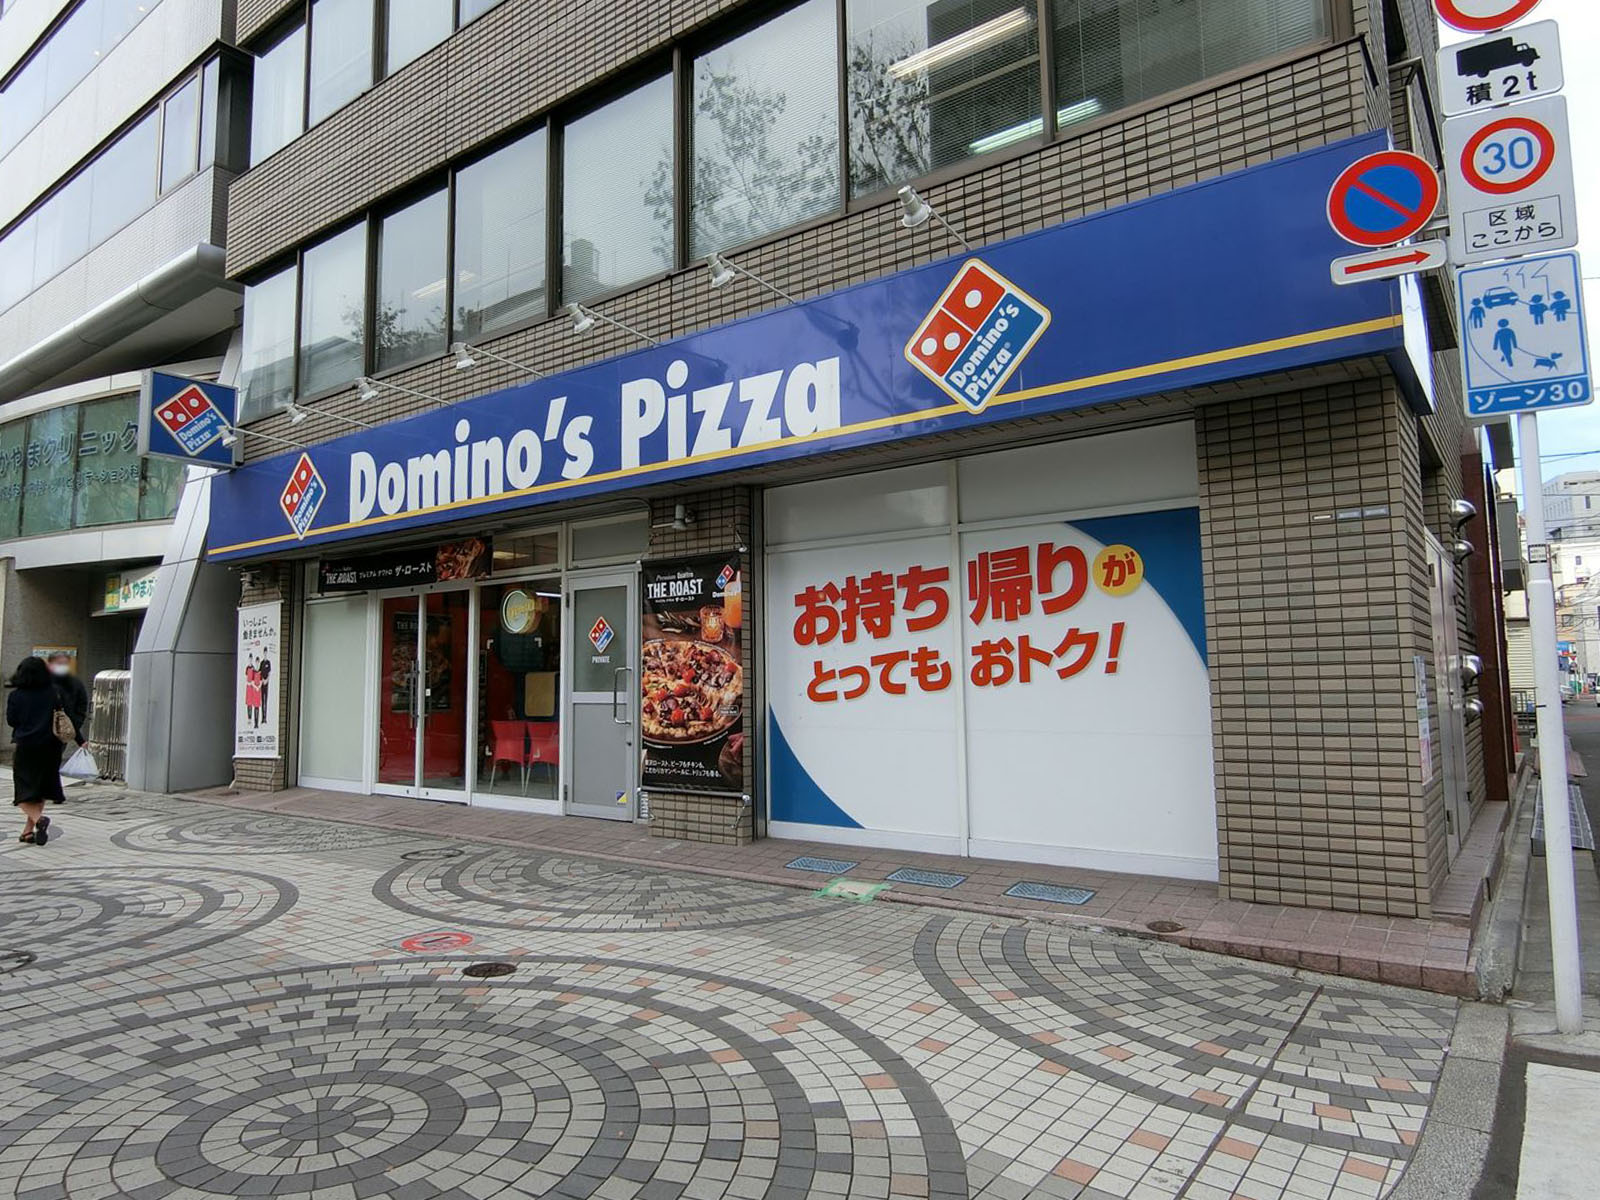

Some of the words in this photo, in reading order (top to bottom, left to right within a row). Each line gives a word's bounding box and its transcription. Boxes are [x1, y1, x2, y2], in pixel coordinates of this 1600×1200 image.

[1482, 136, 1534, 175] 30
[1489, 204, 1536, 227] 区域
[1472, 221, 1557, 249] ここから
[949, 303, 1020, 389] Domino's
[964, 347, 1013, 401] Pizza
[1474, 381, 1584, 411] ゾーン30
[178, 412, 217, 442] Domino's
[186, 431, 212, 451] Pizza
[349, 396, 594, 513] Domino's
[621, 359, 841, 470] Pizza
[293, 480, 318, 525] Domino's
[647, 582, 667, 599] THE
[669, 578, 704, 597] ROAST
